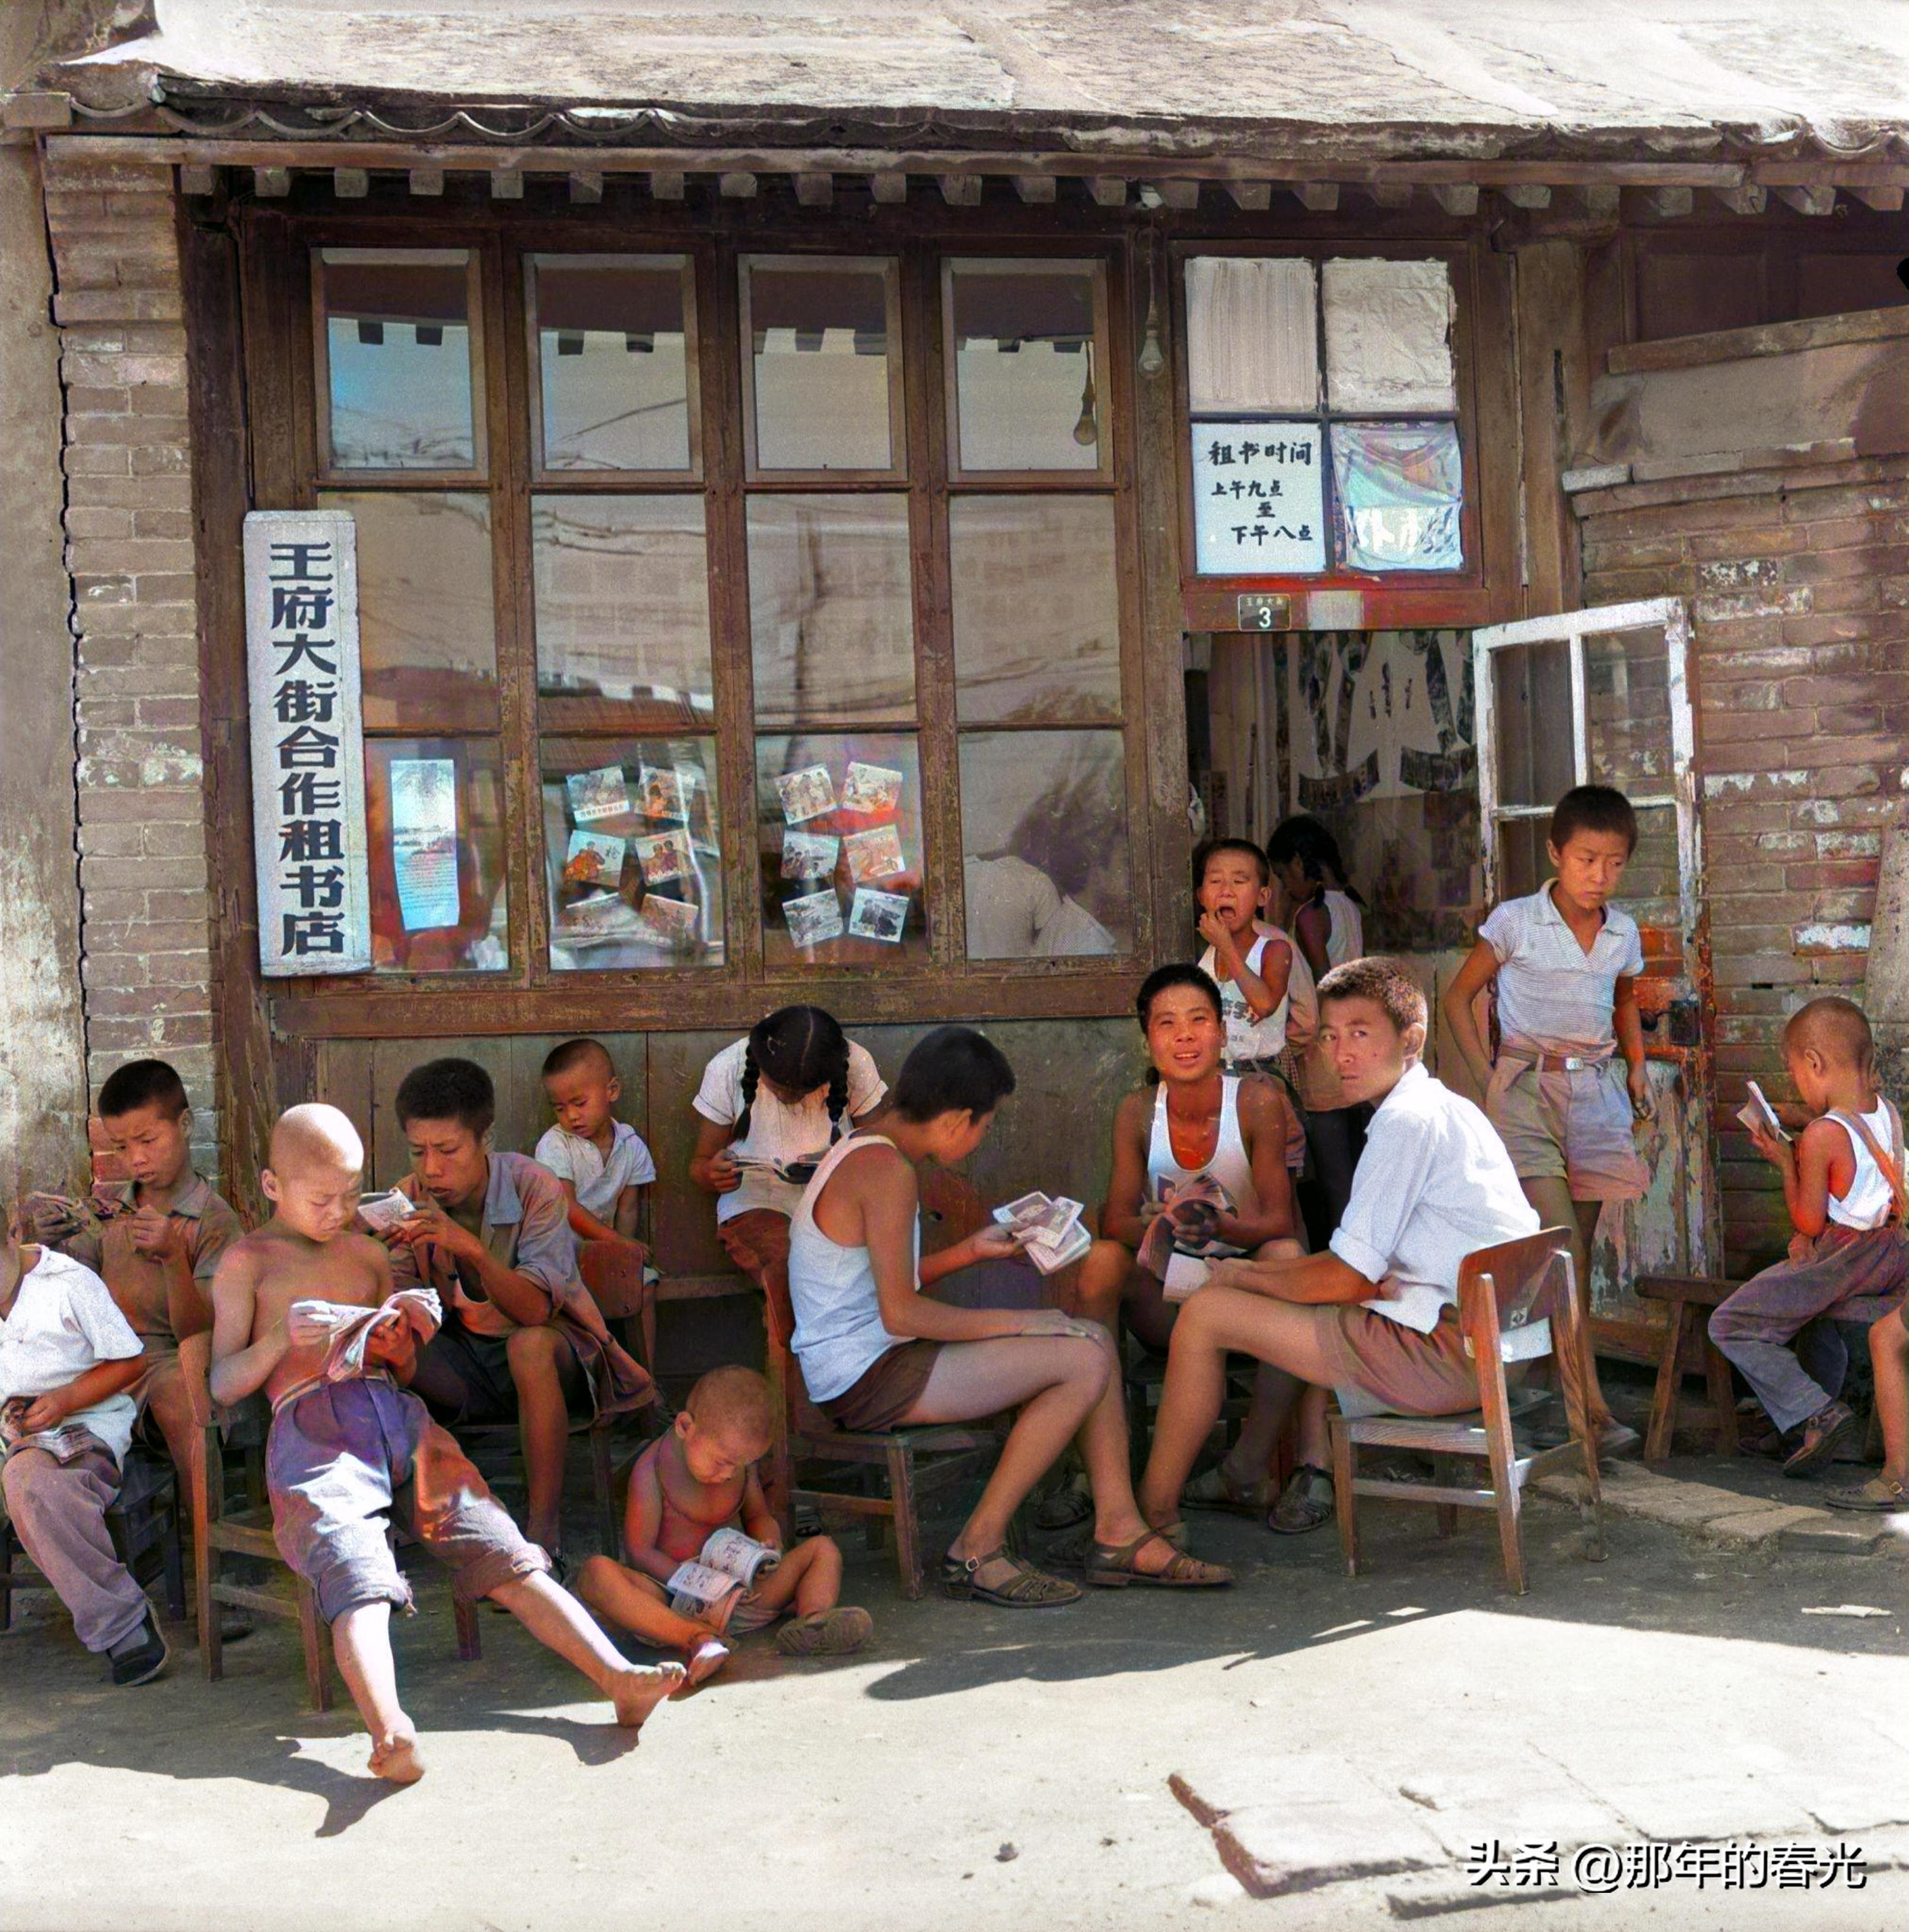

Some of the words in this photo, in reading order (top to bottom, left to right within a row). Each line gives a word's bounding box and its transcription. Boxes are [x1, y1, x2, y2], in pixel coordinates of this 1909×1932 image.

[1208, 441, 1312, 466] 租书时间
[1211, 480, 1283, 499] 上午九点
[1256, 502, 1275, 518] 至
[1231, 525, 1312, 545] 下午八点
[1259, 606, 1271, 628] 3
[269, 542, 345, 956] 王府大街合作租书店
